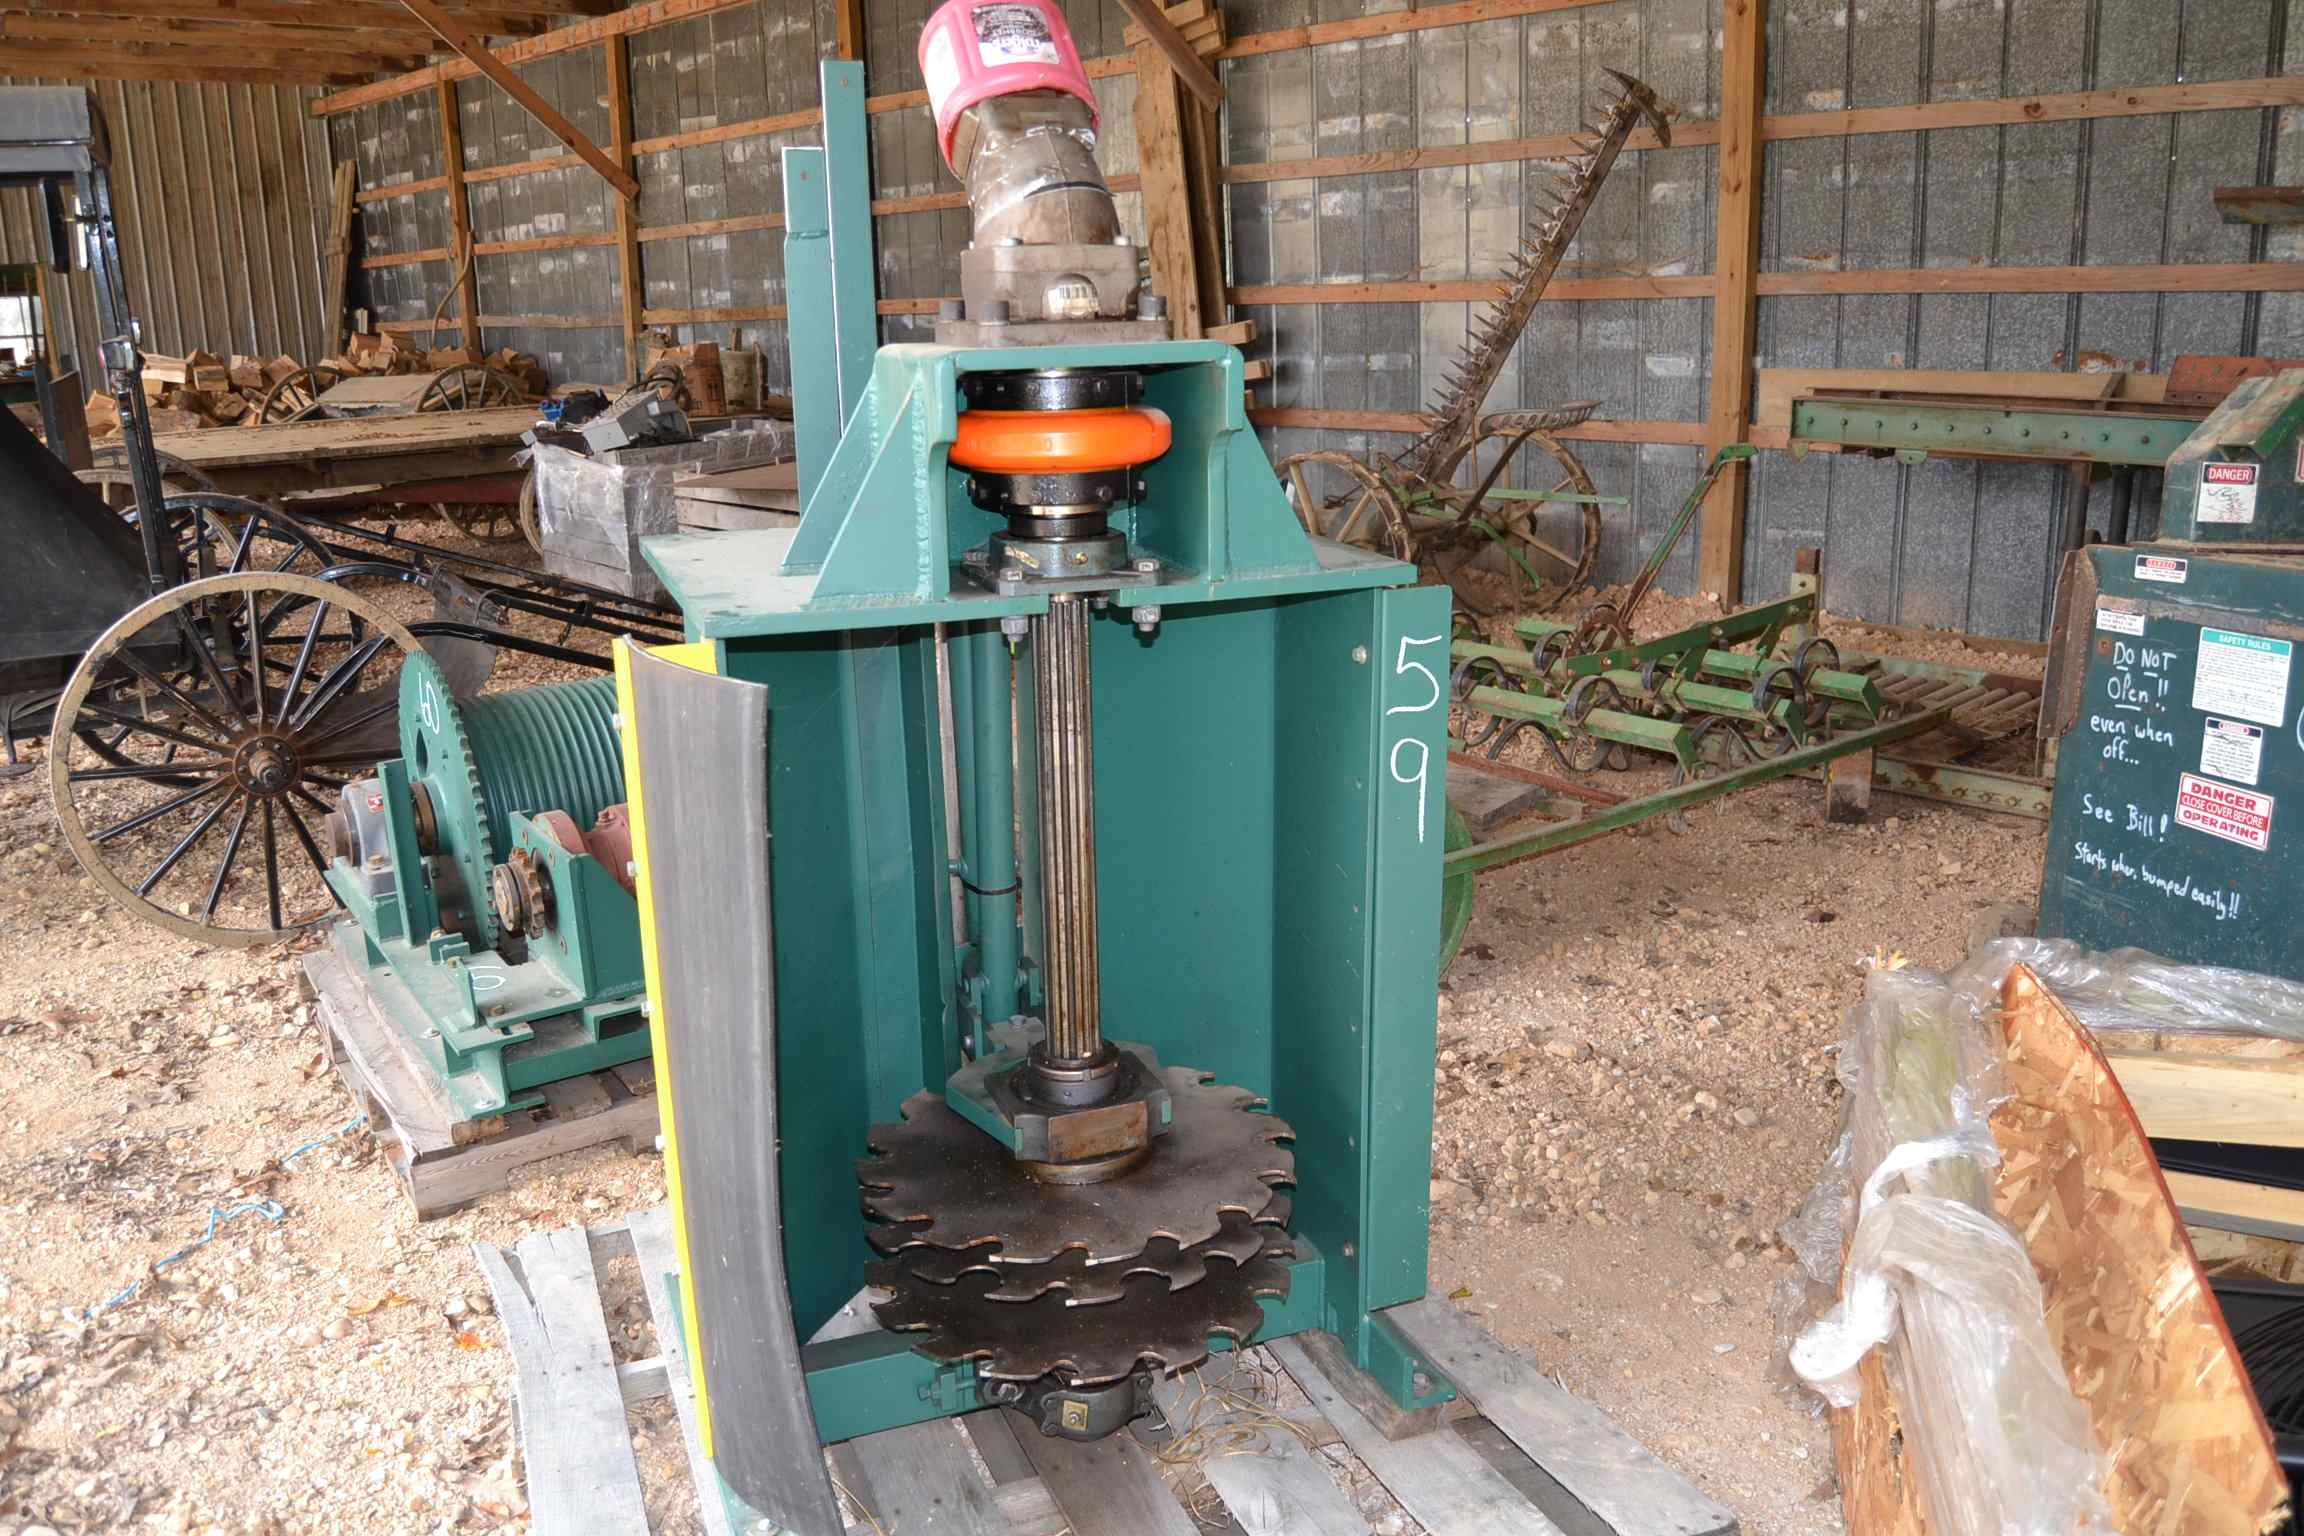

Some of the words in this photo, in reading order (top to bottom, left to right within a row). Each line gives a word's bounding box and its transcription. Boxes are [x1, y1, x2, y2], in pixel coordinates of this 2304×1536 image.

[2208, 467, 2250, 480] DANGER
[2090, 715, 2126, 734] even
[2135, 718, 2173, 747] when
[2082, 793, 2113, 823] See
[2181, 794, 2207, 810] CLOSE
[2207, 800, 2232, 817] COVER
[2233, 808, 2263, 829] BEFORE
[2191, 782, 2257, 811] DANGER
[2183, 810, 2258, 841] OPERATING
[2074, 841, 2107, 871] Starts
[2141, 865, 2191, 898] bumped
